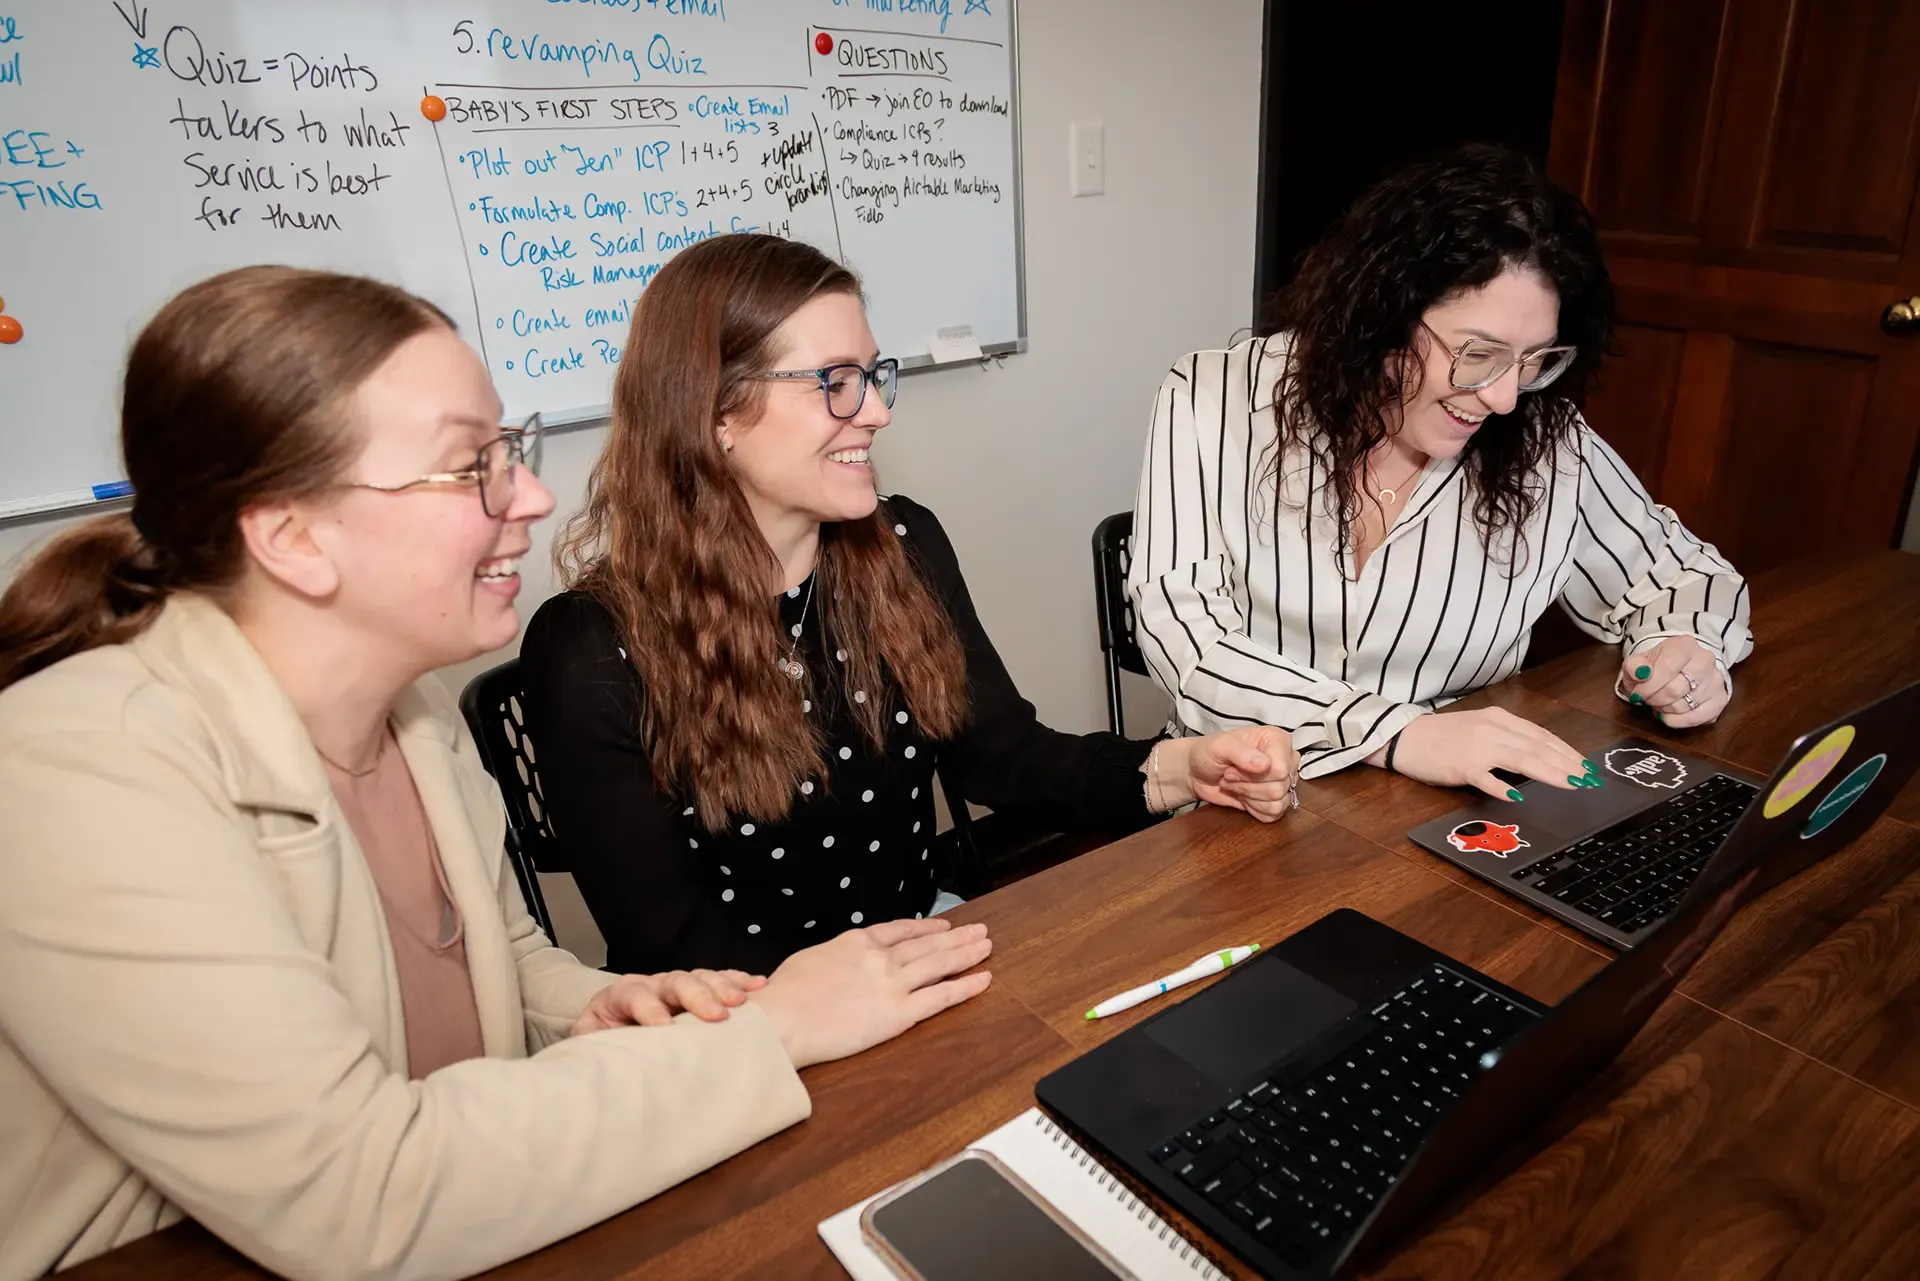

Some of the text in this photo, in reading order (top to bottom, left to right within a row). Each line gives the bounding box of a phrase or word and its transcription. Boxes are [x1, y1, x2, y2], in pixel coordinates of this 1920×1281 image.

[163, 25, 261, 86] Quiz
[487, 28, 640, 82] revamping
[648, 33, 707, 75] Quiz
[838, 39, 948, 74] QUESTIONS
[536, 99, 598, 119] FIRST
[610, 98, 677, 121] STEPS
[748, 95, 789, 116] Email
[826, 86, 860, 111] PDF
[884, 88, 910, 117] join
[939, 91, 952, 109] to
[297, 117, 327, 143] to
[344, 108, 410, 148] what
[767, 122, 779, 136] 3
[834, 120, 898, 146] Compliance
[295, 162, 318, 192] is
[326, 160, 391, 195] best
[467, 147, 511, 179] Plot
[524, 150, 557, 175] out
[636, 141, 670, 172] ICP
[863, 149, 895, 171] Quiz
[924, 149, 965, 169] results
[842, 176, 899, 208] Changing
[954, 177, 1001, 203] Marketing
[195, 196, 342, 231] for them
[501, 231, 577, 267] Create
[590, 227, 644, 257] Social
[512, 299, 631, 337] Create email
[525, 347, 585, 378] Create
